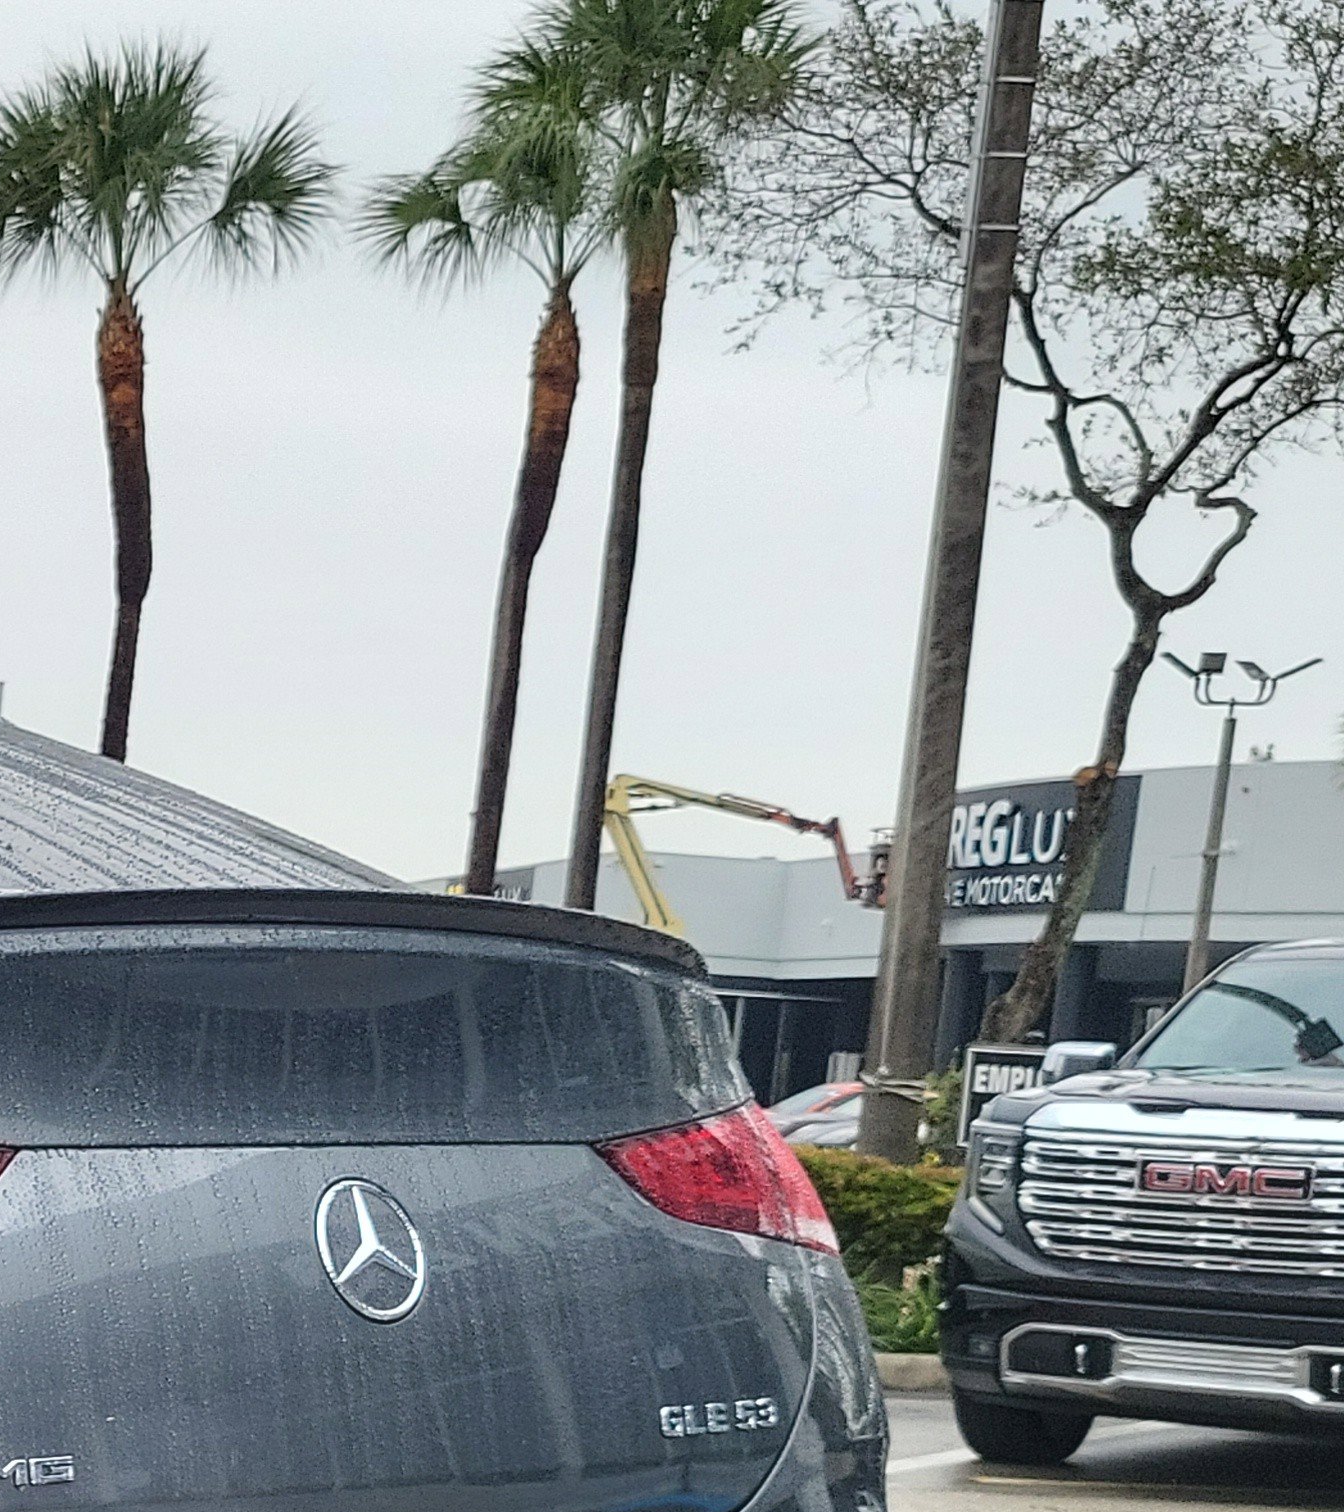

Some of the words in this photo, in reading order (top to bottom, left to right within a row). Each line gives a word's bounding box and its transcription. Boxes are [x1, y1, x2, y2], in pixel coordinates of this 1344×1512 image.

[946, 799, 1076, 870] REGLU
[1144, 1161, 1307, 1200] GMC
[659, 1402, 731, 1438] GLE
[734, 1397, 780, 1430] 53
